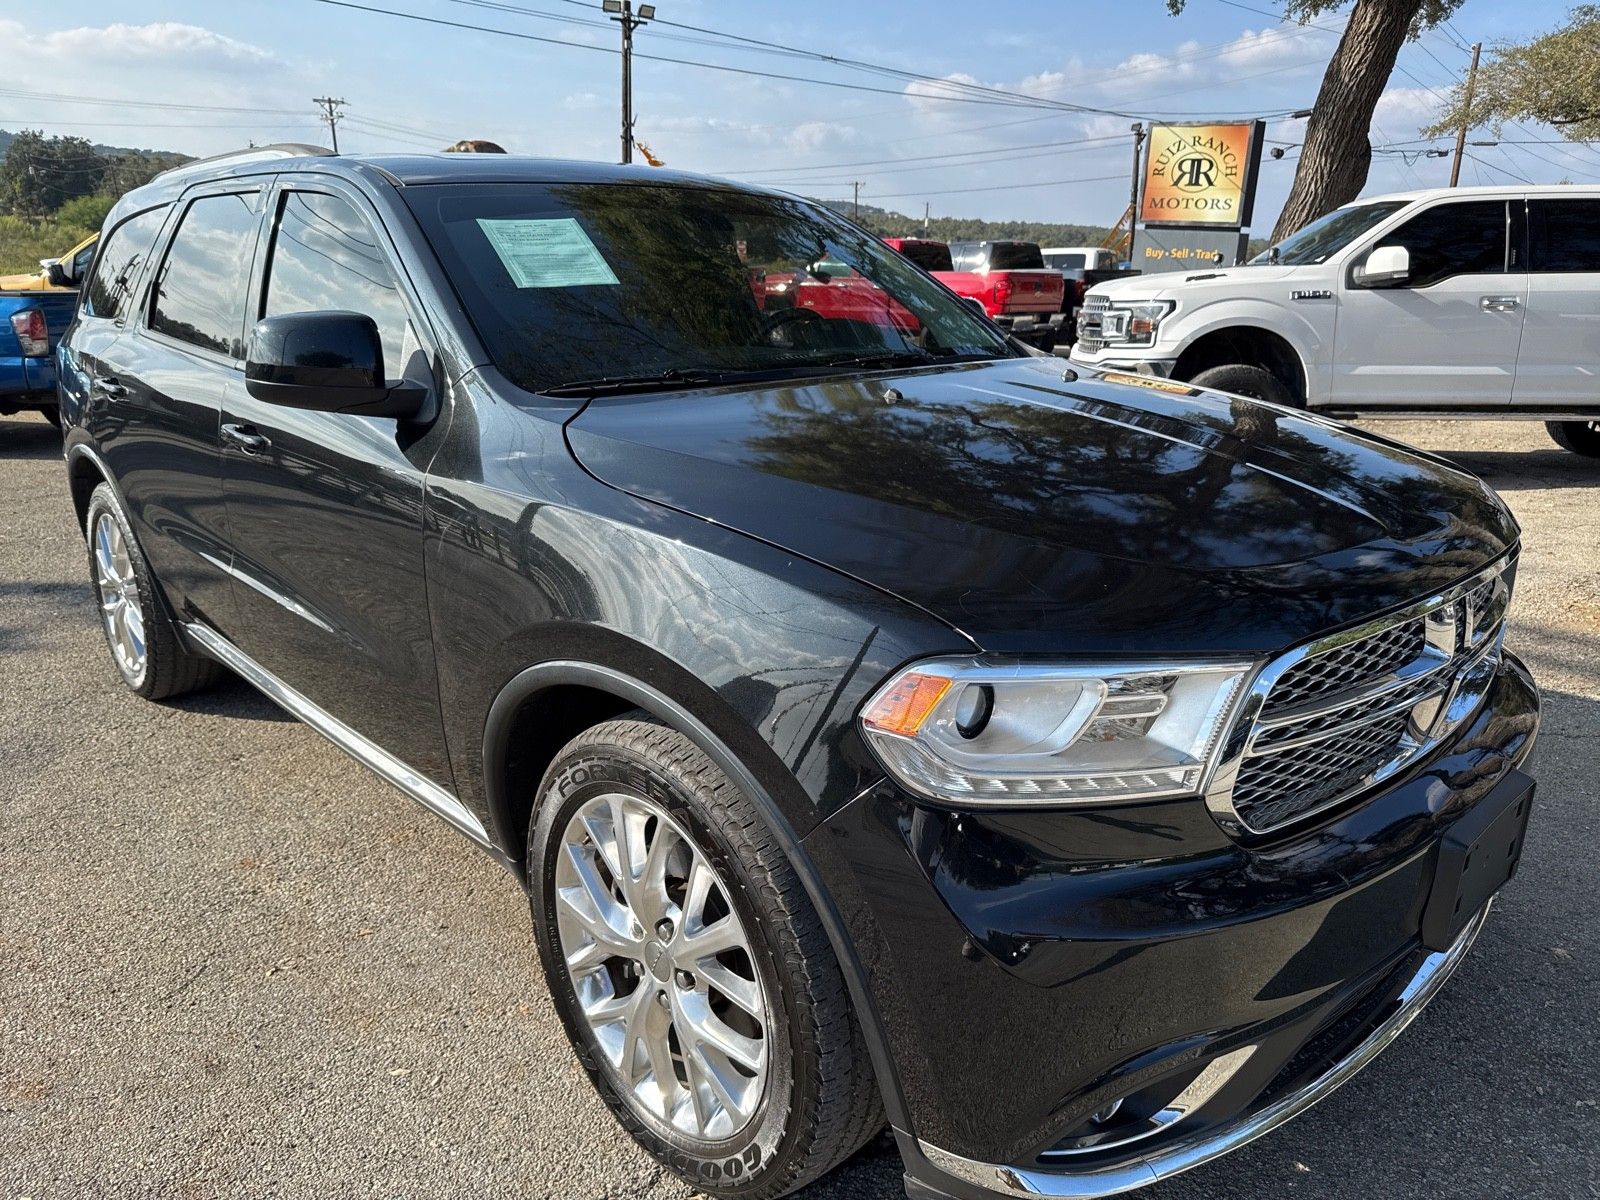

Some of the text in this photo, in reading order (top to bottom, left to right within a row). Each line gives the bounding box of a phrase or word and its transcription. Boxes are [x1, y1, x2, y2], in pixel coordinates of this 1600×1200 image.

[1152, 136, 1238, 177] RUIZ RANCH
[1149, 197, 1232, 210] MOTORS
[1145, 247, 1219, 260] Buy Sell Trad
